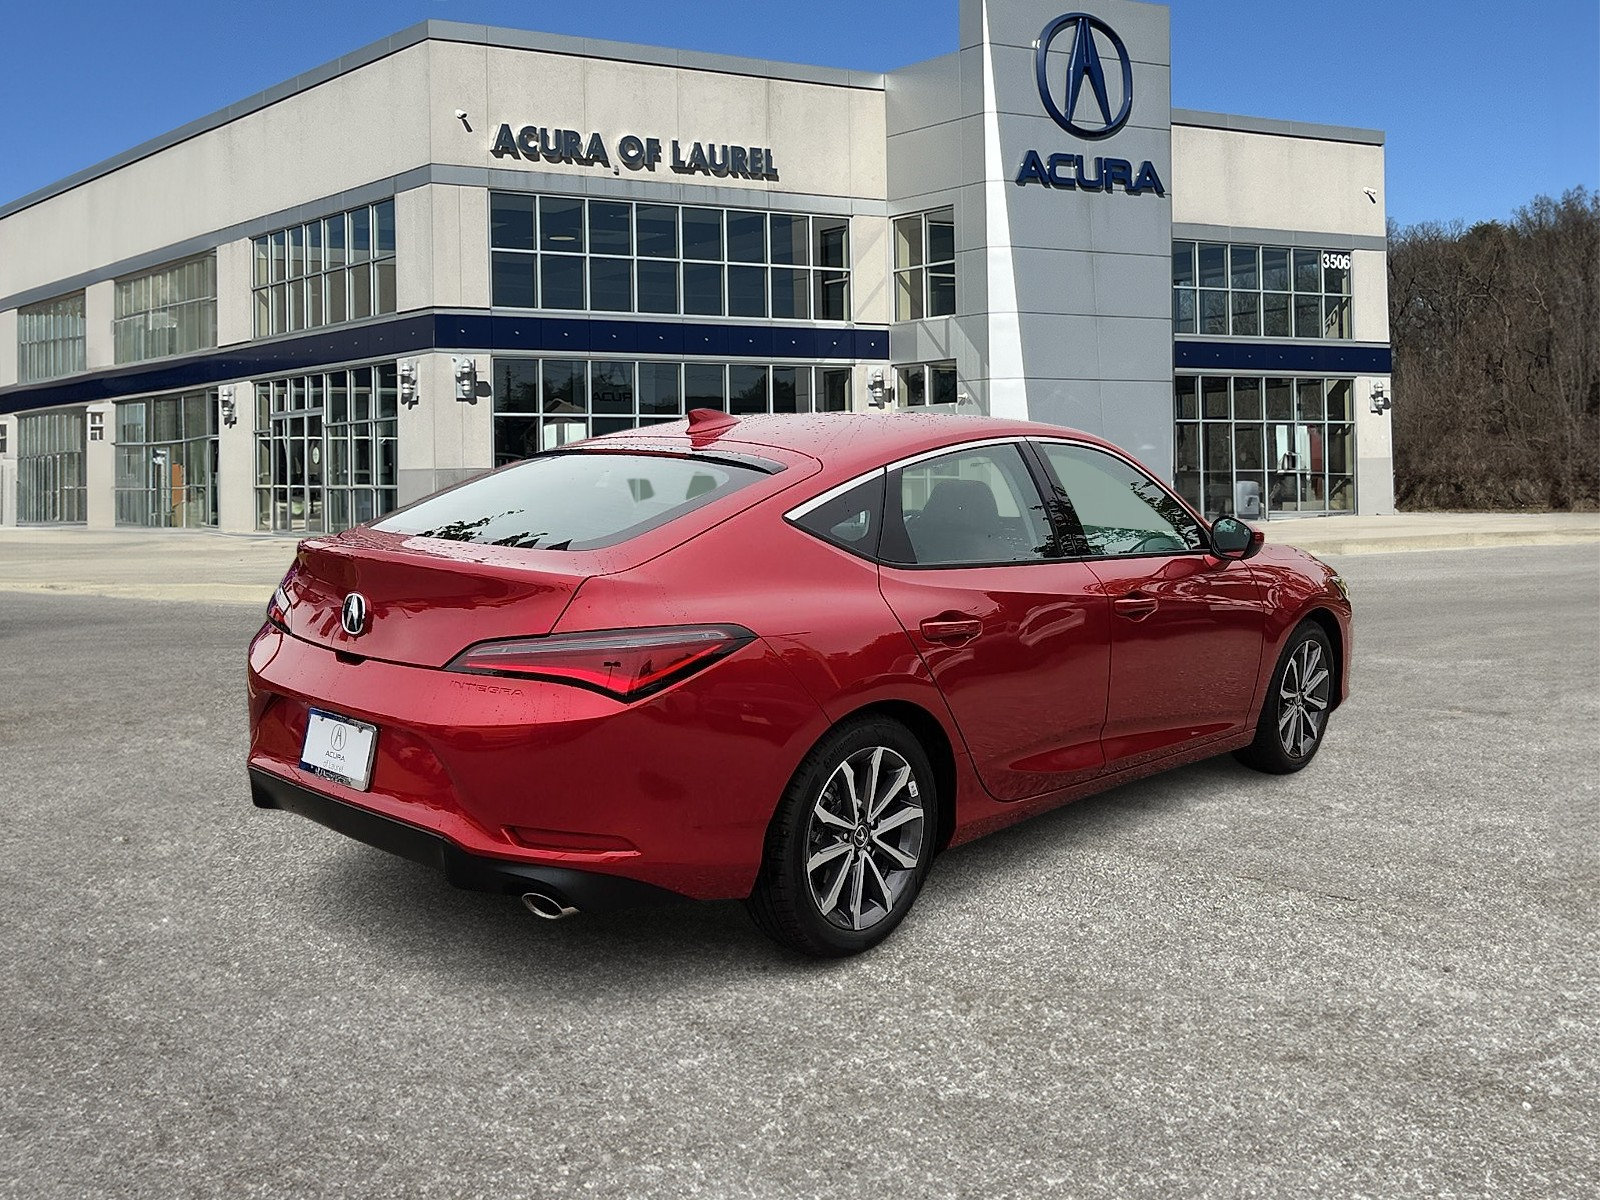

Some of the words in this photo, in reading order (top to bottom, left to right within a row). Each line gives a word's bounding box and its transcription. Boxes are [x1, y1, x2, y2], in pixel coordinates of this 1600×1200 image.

[490, 123, 611, 168] ACURA
[617, 135, 662, 171] OF
[670, 139, 779, 181] LAUREL
[1015, 150, 1166, 198] ACURA
[1322, 253, 1351, 269] 3506
[592, 391, 632, 402] ACUR
[450, 680, 524, 696] INTEGRA
[325, 750, 346, 762] ACURA
